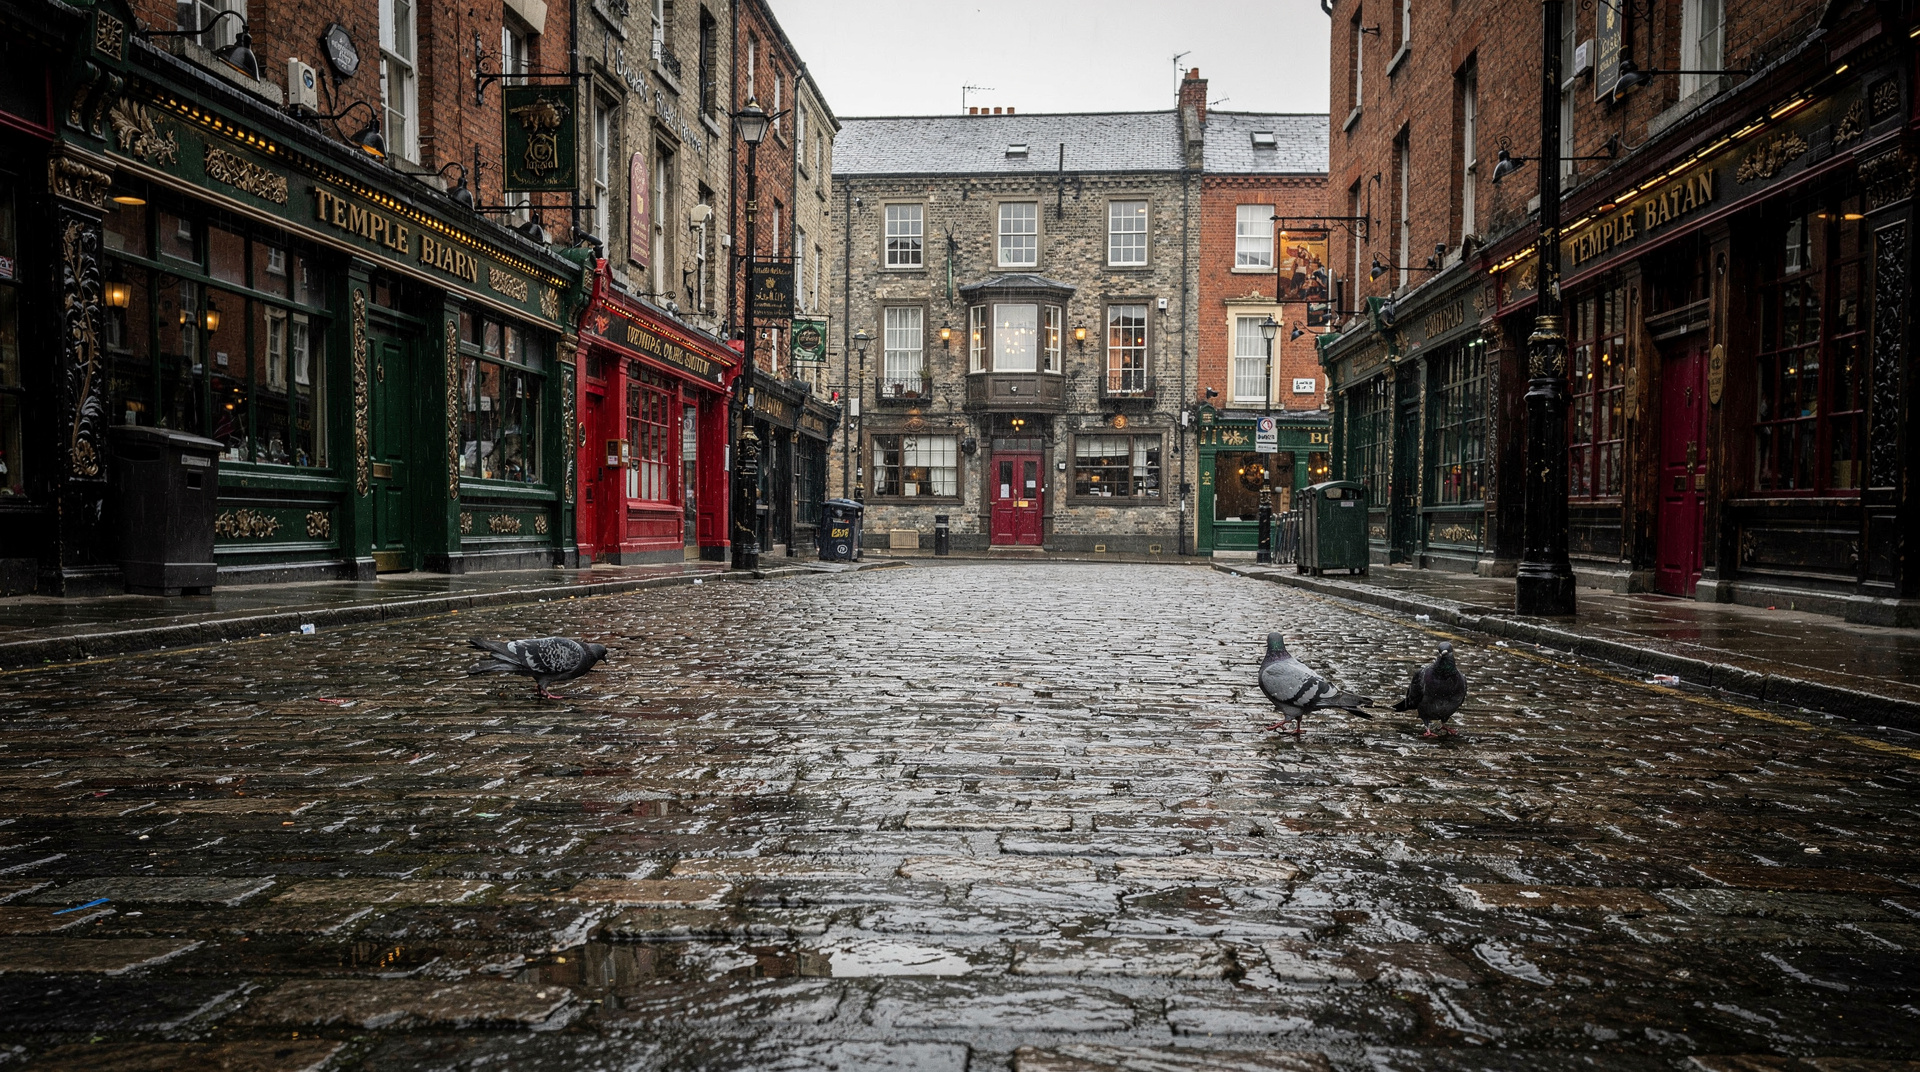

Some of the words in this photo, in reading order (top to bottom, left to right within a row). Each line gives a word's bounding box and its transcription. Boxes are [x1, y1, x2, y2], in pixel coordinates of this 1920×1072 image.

[314, 185, 409, 255] TEMPLE
[420, 234, 479, 284] BIARN
[1569, 209, 1635, 266] TEMPLE
